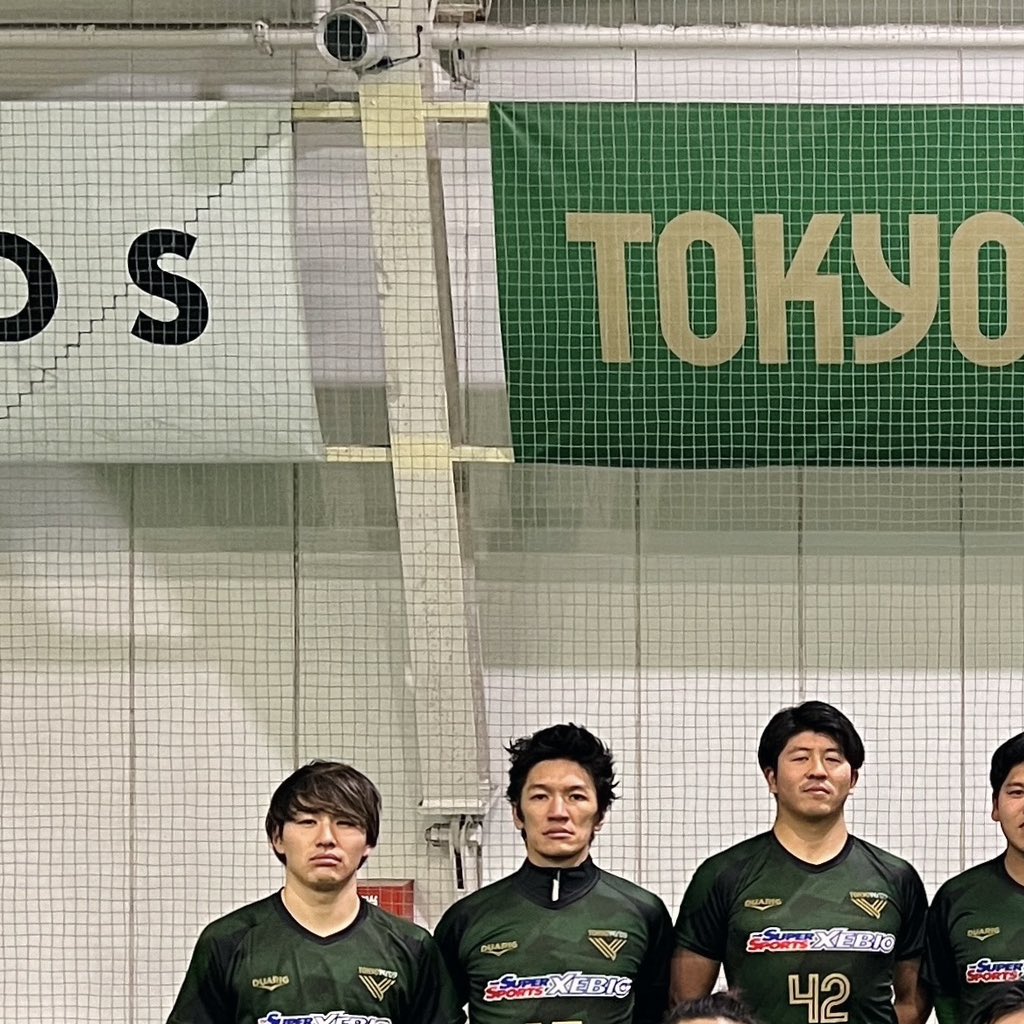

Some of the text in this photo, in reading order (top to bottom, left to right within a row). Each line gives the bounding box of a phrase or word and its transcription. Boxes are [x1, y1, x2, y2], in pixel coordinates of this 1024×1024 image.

[762, 929, 814, 942] SUPER
[812, 929, 895, 952] XEBIO
[747, 939, 808, 951] SPORTS
[976, 961, 1023, 973] SUPER
[500, 974, 549, 988] SUPER
[967, 970, 1018, 981] SPORTS
[484, 987, 544, 999] SPORTS
[788, 973, 850, 1023] 42
